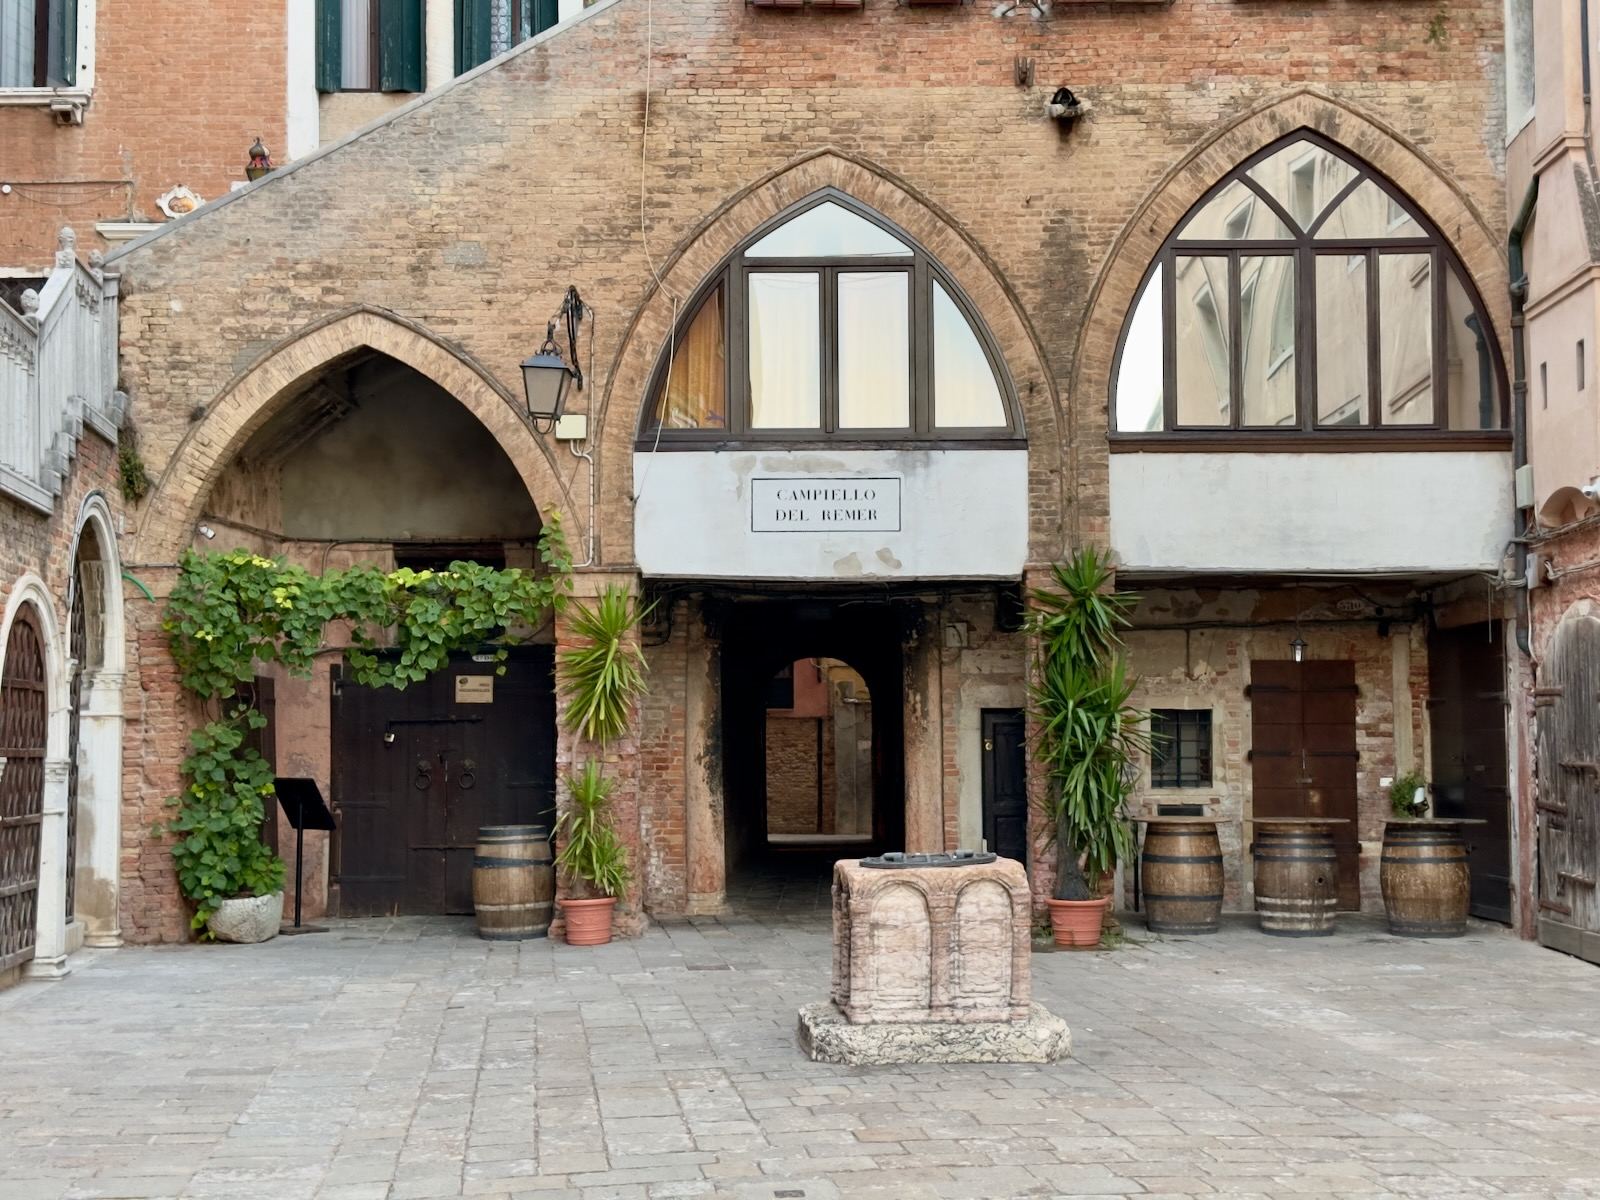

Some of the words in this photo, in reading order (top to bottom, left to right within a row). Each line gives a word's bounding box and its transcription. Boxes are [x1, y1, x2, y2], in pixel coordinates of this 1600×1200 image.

[777, 489, 876, 501] CAMPIELLO
[776, 509, 810, 521] DEL
[822, 509, 878, 521] REMER
